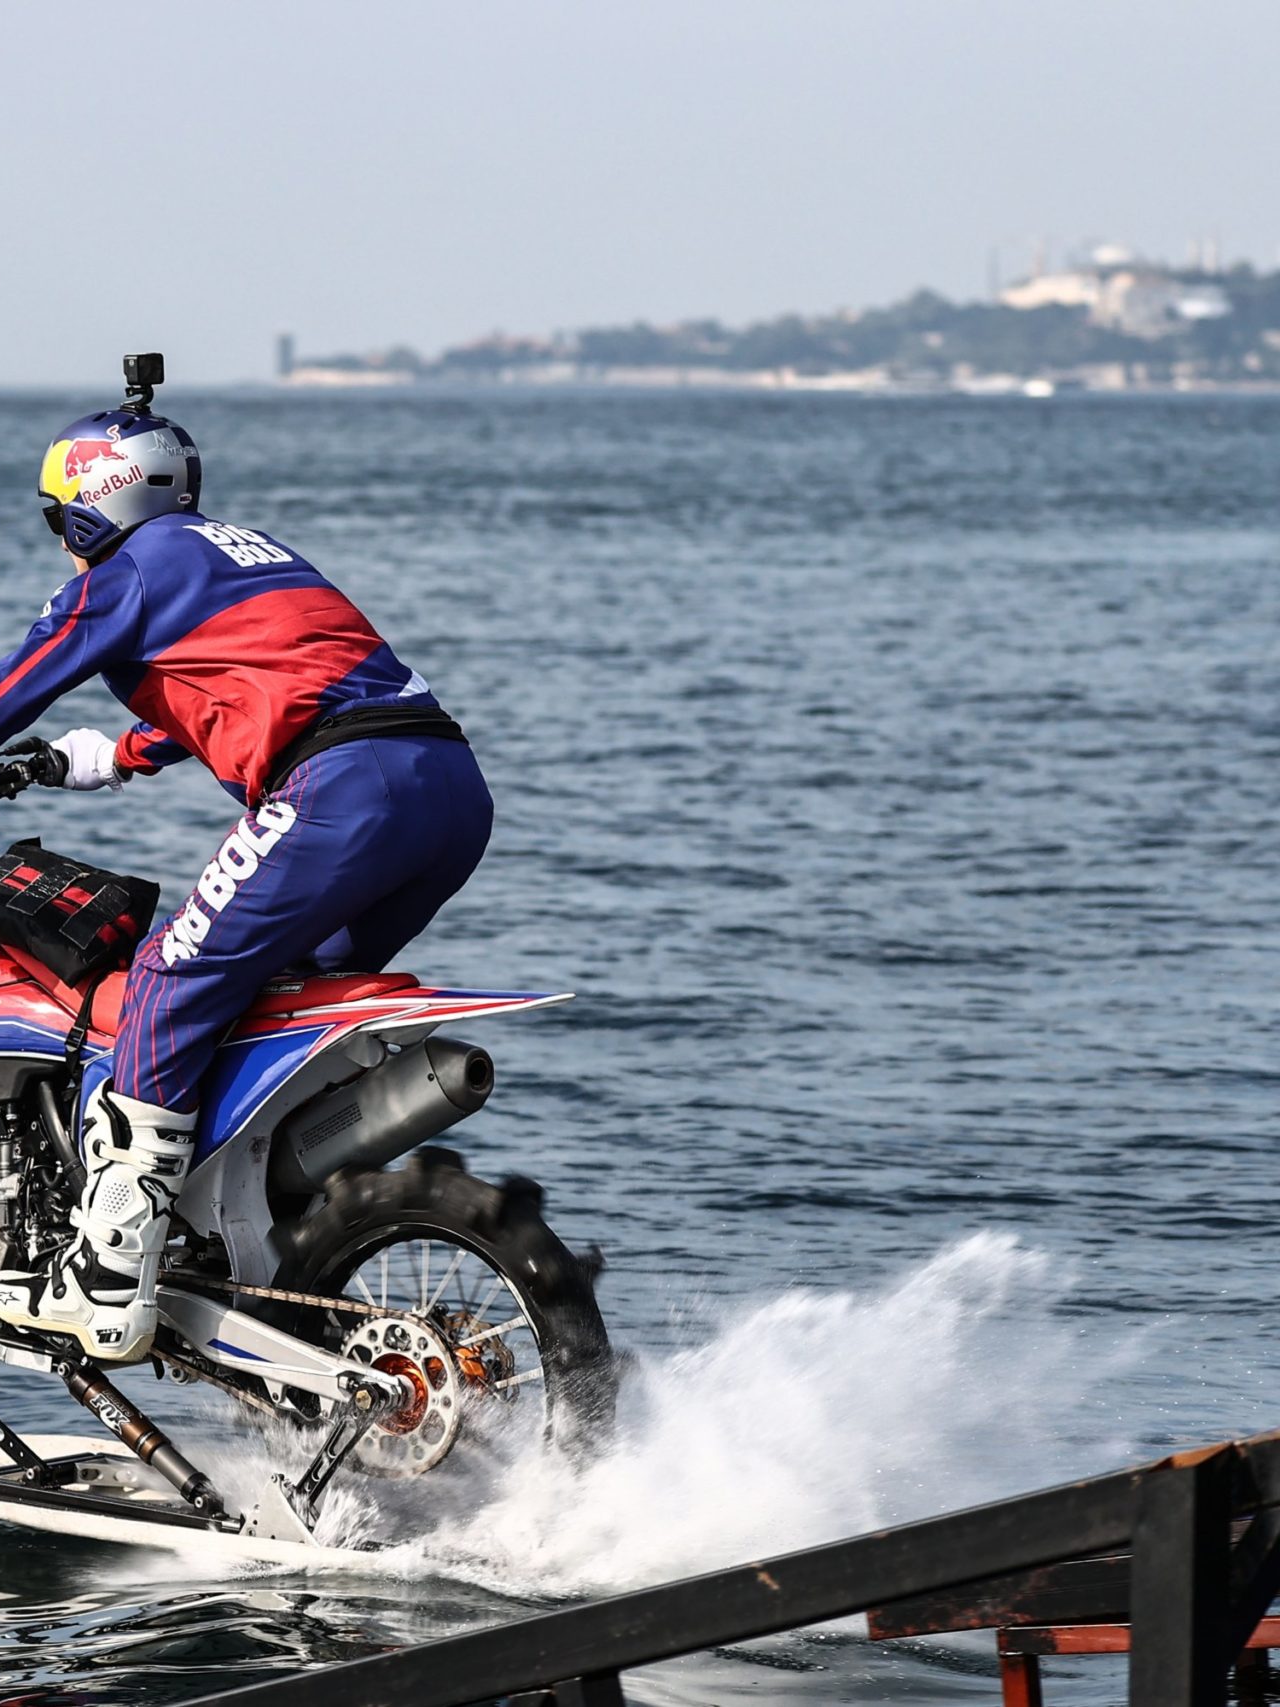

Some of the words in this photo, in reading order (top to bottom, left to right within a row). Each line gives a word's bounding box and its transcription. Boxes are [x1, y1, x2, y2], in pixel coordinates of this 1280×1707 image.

[82, 478, 112, 507] Red
[109, 464, 144, 491] Bull
[217, 543, 294, 567] BOLD
[197, 801, 297, 913] BOLD
[89, 1393, 131, 1430] FOX
